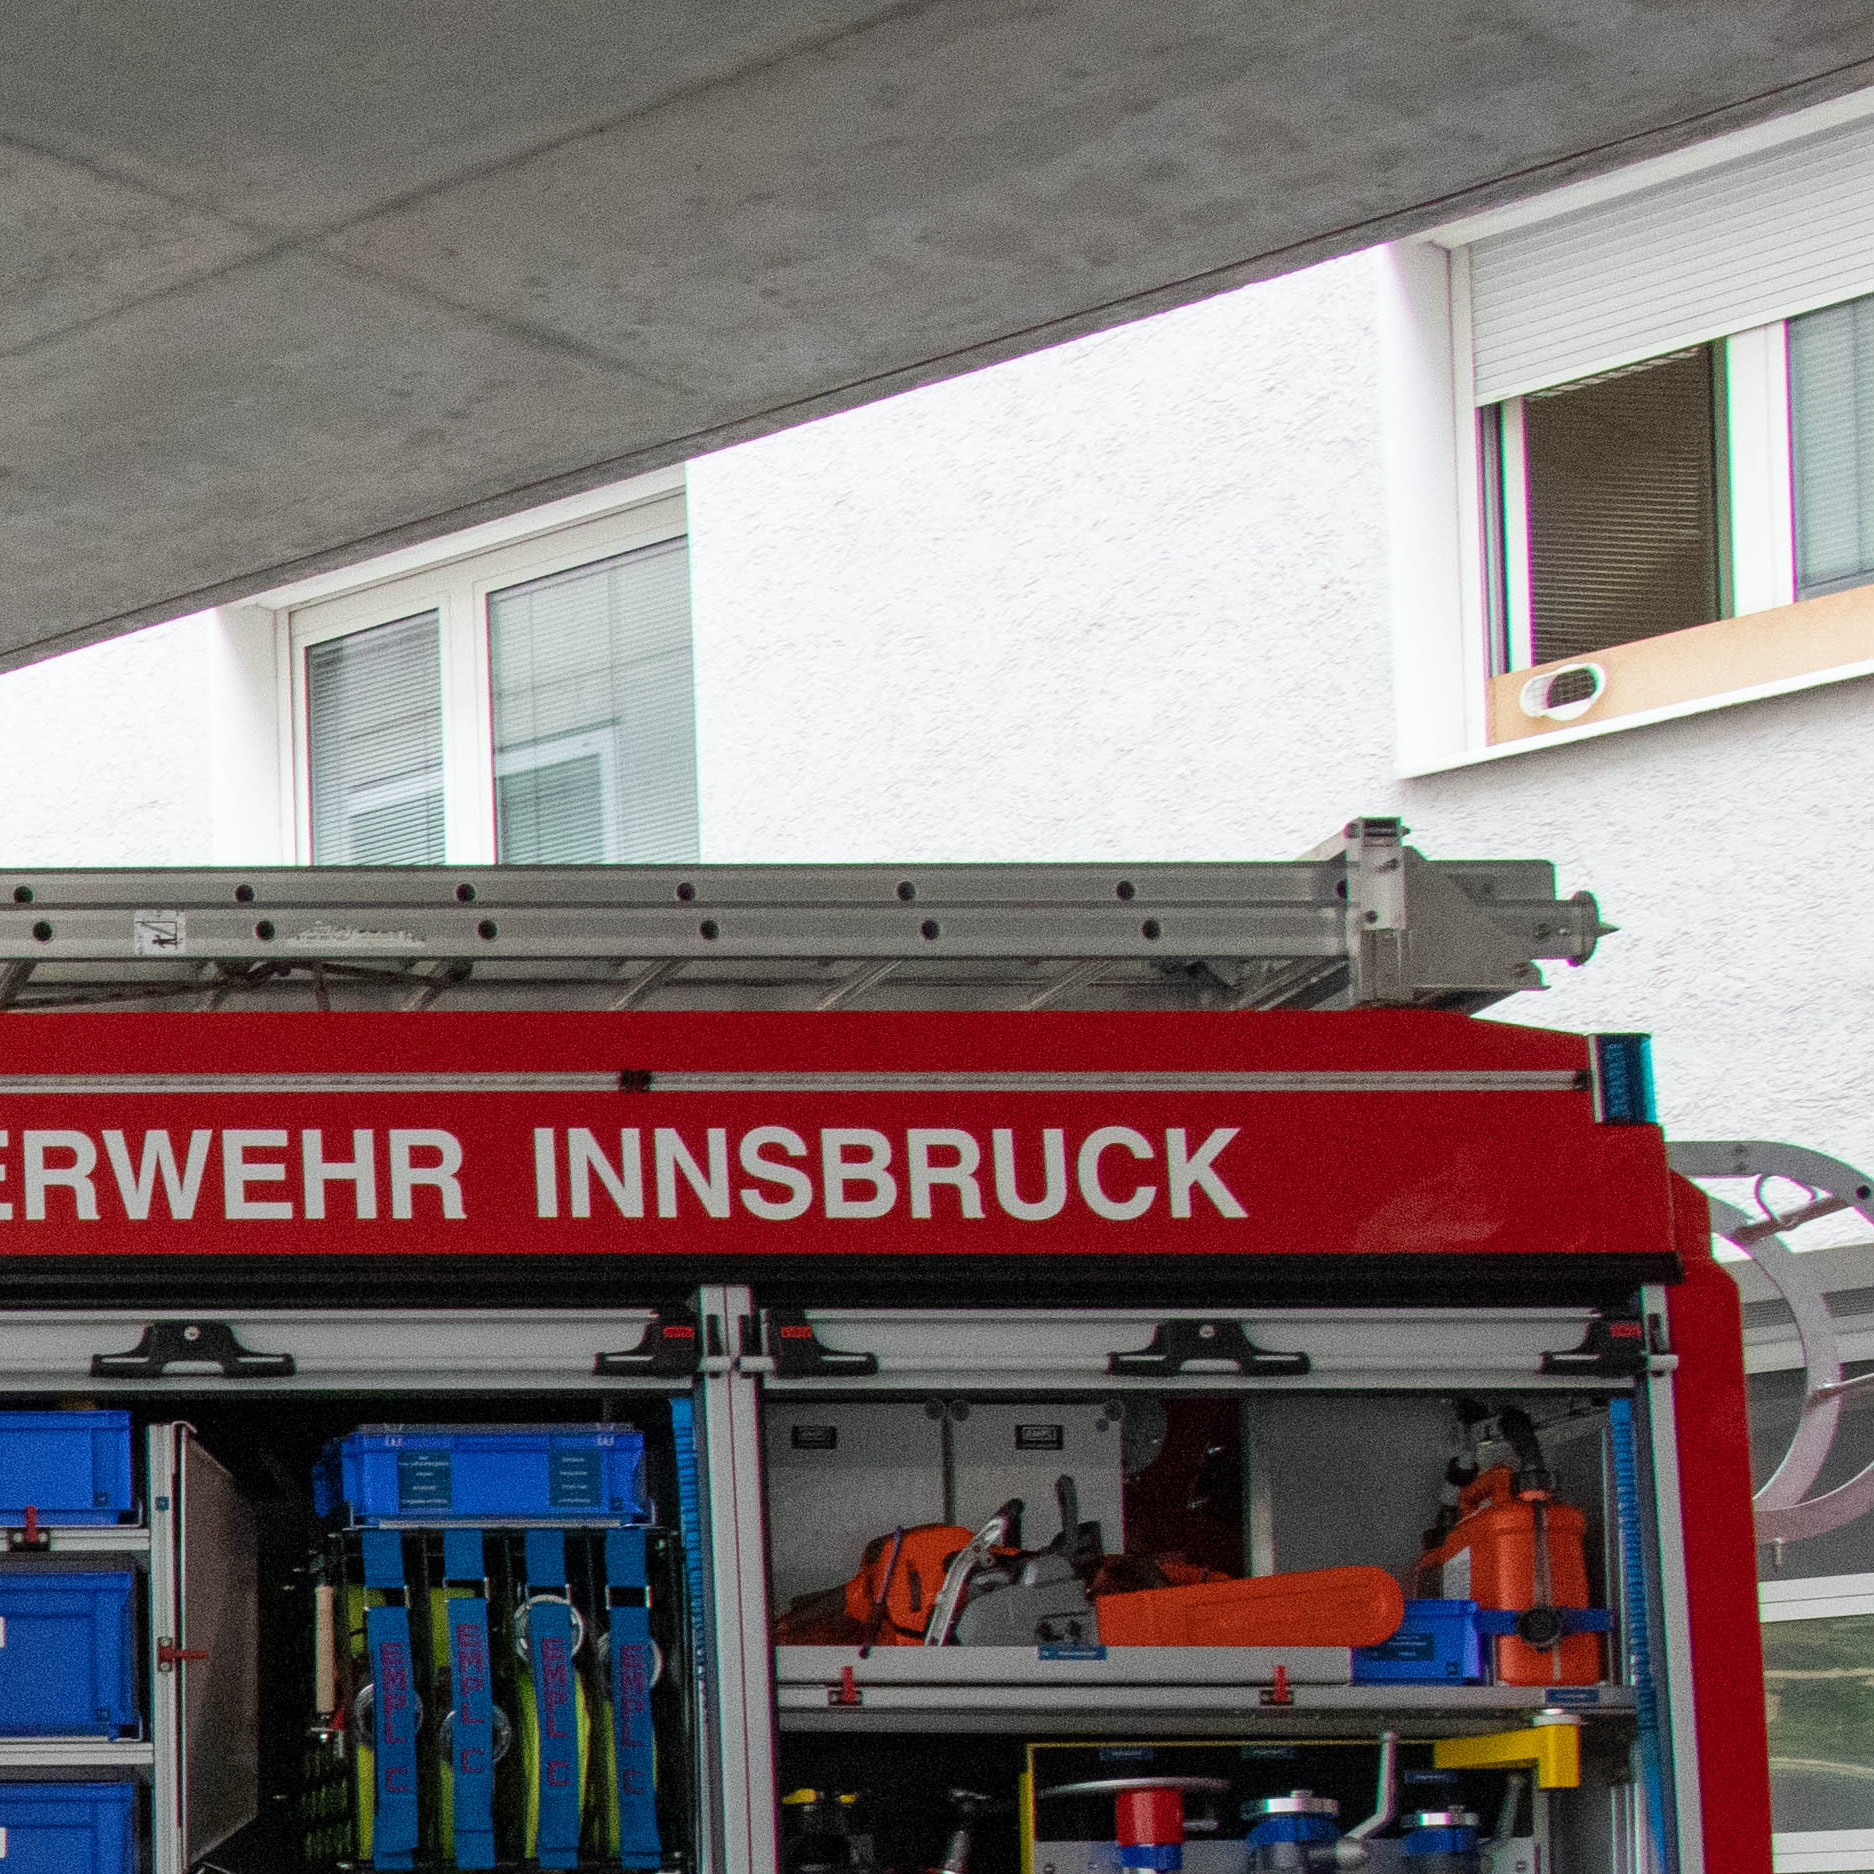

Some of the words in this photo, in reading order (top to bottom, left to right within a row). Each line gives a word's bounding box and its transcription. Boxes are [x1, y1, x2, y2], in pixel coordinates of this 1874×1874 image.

[534, 1125, 1246, 1224] INNSBRUCK
[381, 1641, 408, 1745] EMPL
[455, 1623, 485, 1725] EMPL
[541, 1637, 570, 1739] EMPL
[620, 1644, 646, 1748] EMPL
[385, 1767, 409, 1793] C
[461, 1748, 486, 1774] C
[547, 1760, 571, 1787] C
[623, 1769, 645, 1795] C
